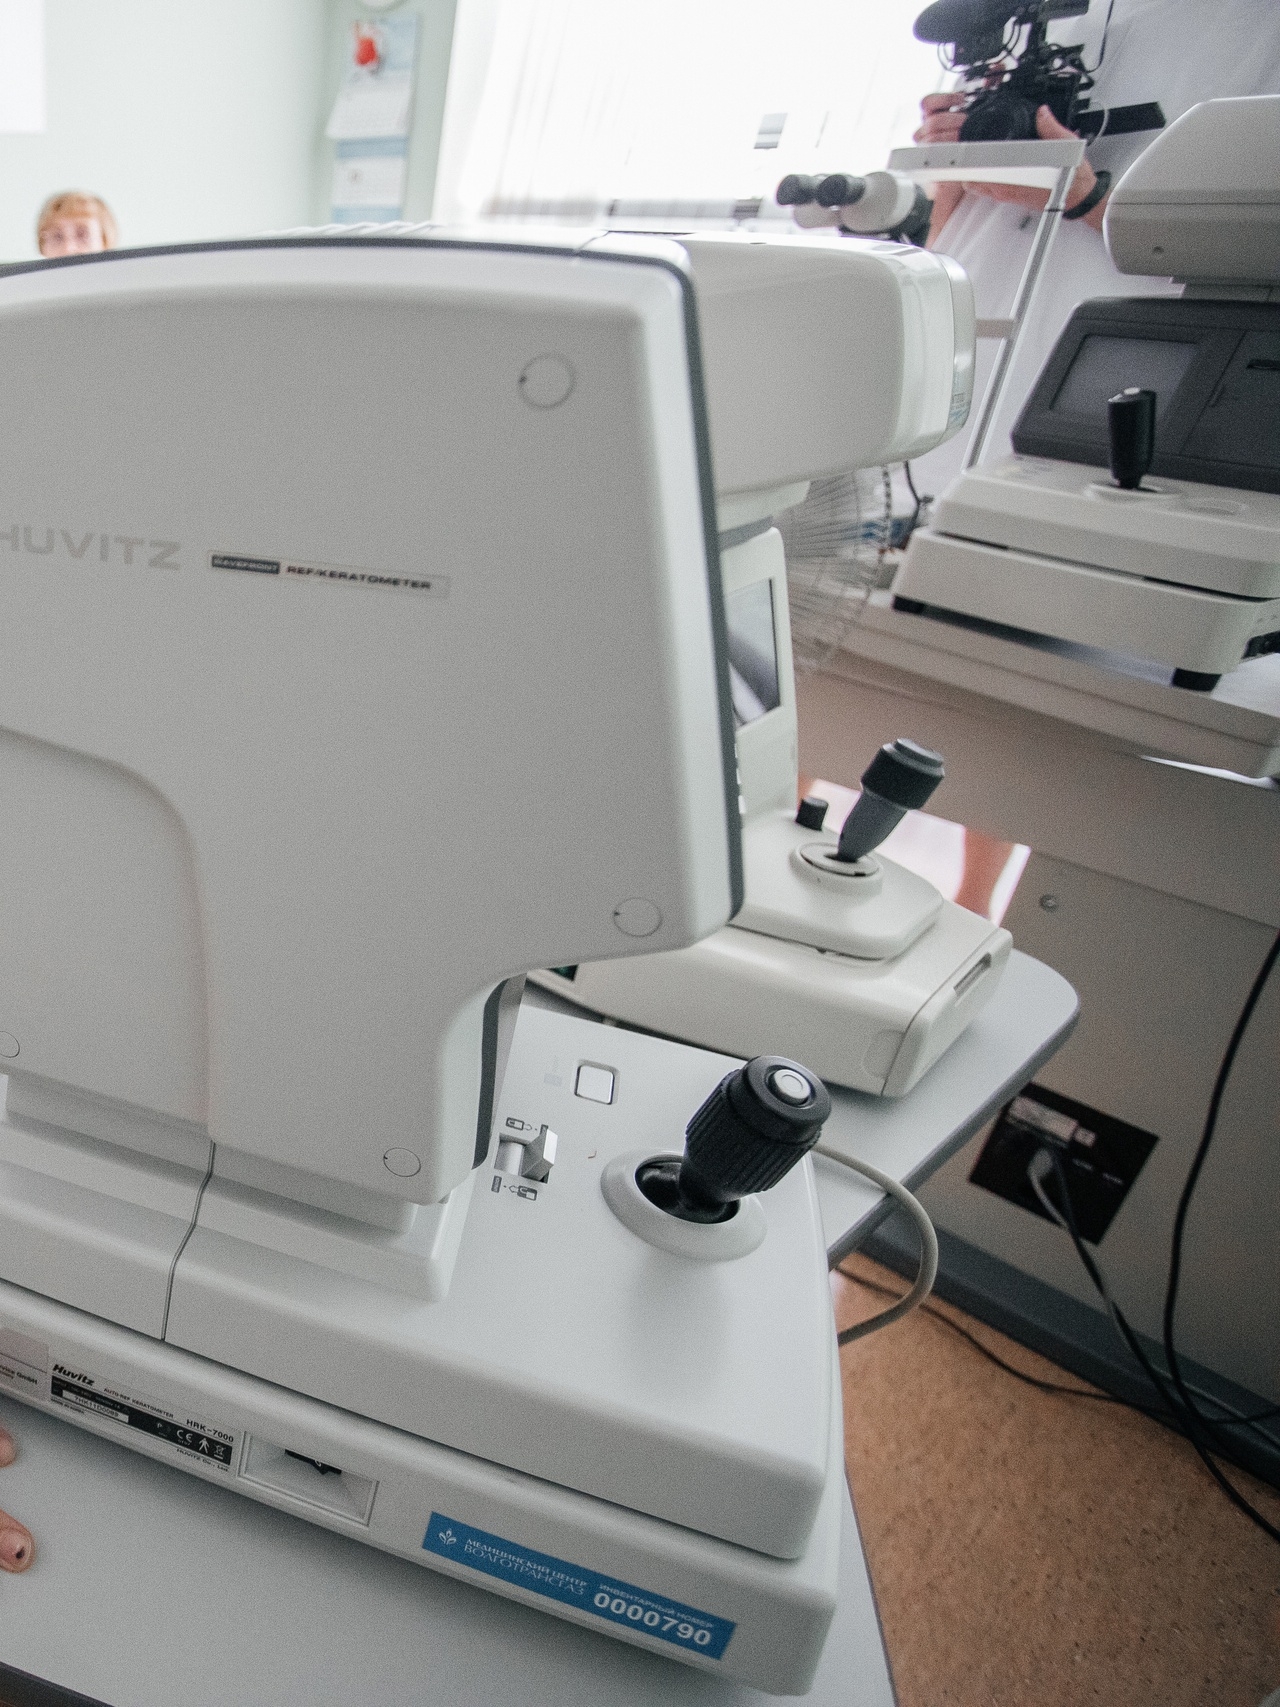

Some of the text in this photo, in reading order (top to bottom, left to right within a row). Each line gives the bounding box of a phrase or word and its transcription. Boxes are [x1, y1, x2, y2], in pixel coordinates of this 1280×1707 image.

[52, 1364, 95, 1387] Huvitz
[186, 1418, 234, 1443] HRK-7000
[464, 1544, 584, 1595] ВОЛГОТРАНСГАЗ
[466, 1538, 588, 1587] МЕДИЦИНСКИЙ ЦЕНТР
[593, 1592, 711, 1646] 0000790
[599, 1583, 714, 1628] ИНВЕНТАРНЫЙ НОМЕР
